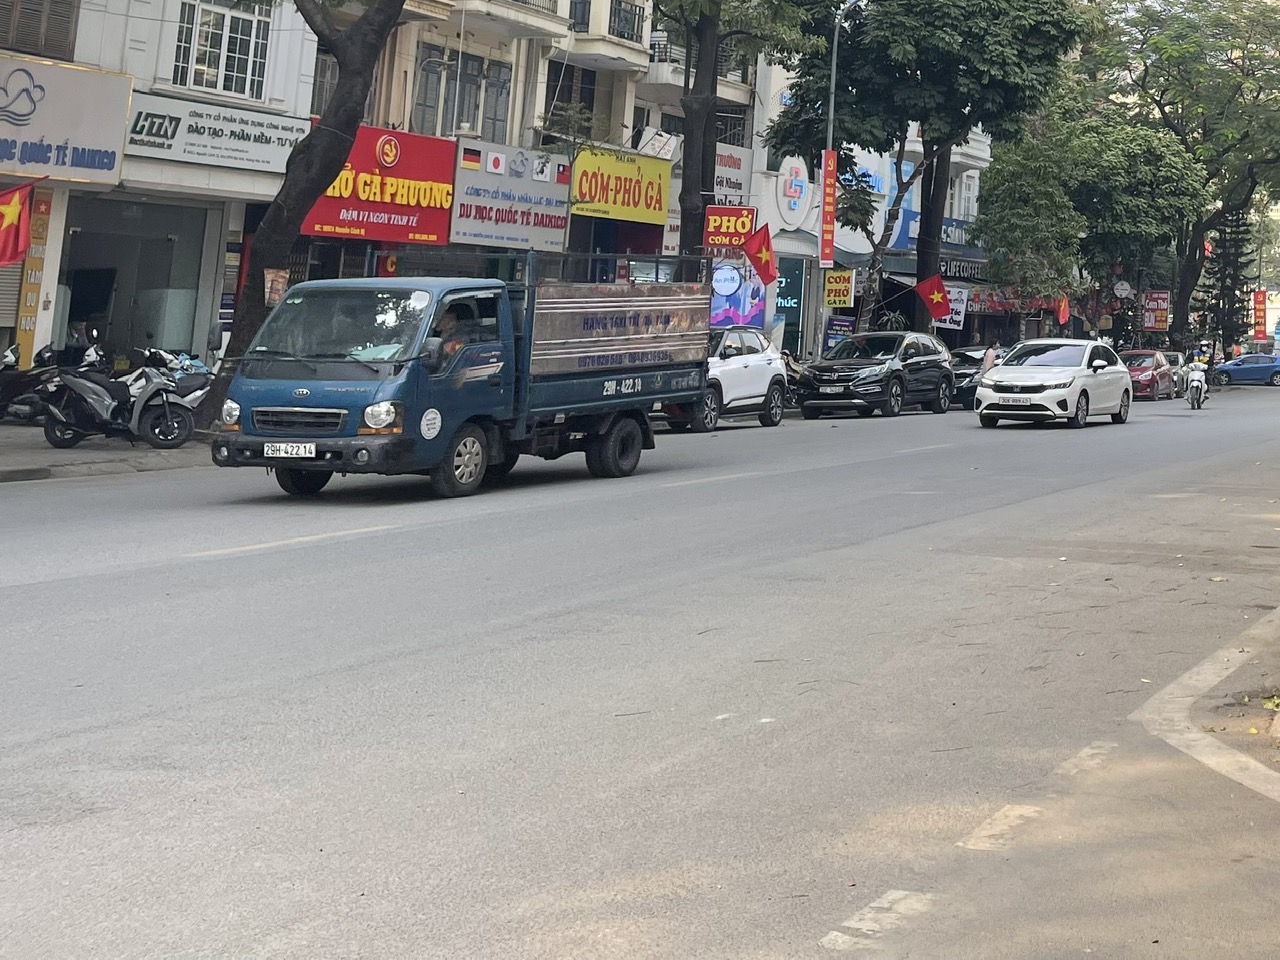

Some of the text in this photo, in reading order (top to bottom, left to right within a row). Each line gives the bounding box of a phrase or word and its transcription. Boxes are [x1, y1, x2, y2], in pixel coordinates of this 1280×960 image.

[187, 123, 205, 136] ĐÀO
[206, 127, 224, 139] TẠO
[229, 128, 251, 142] PHẦN
[253, 131, 272, 145] MỀM
[357, 168, 382, 201] GÀ
[383, 176, 453, 209] PHƯƠNG
[645, 173, 663, 212] GÀ
[459, 203, 473, 219] DU
[495, 203, 518, 225] QUỐC
[520, 206, 533, 226] TẾ
[706, 209, 753, 234] PHỞ
[708, 234, 730, 245] CƠM
[827, 274, 851, 284] CƠM
[947, 261, 960, 278] LIFE
[827, 285, 850, 297] PHỞ
[776, 296, 798, 307] húc
